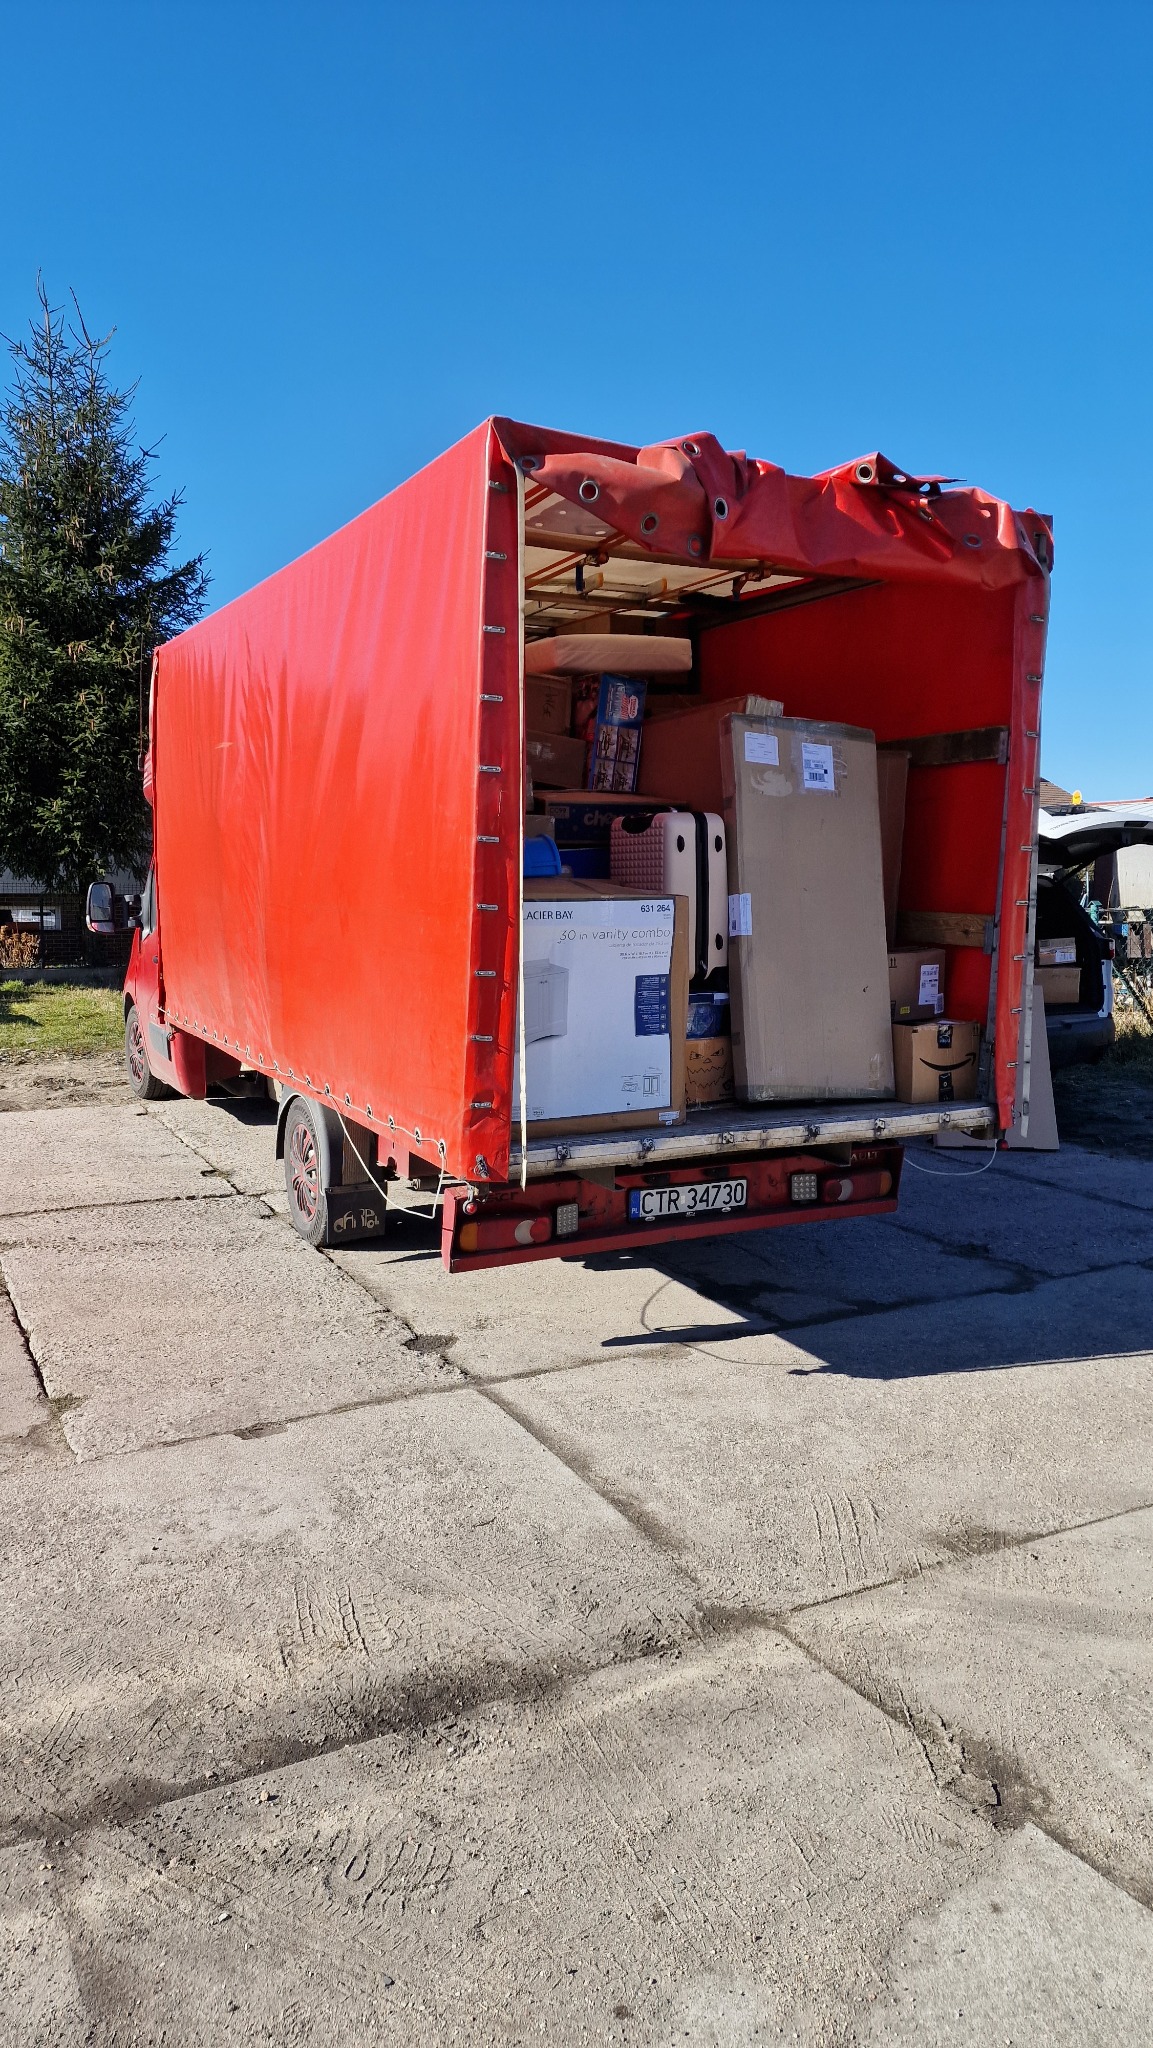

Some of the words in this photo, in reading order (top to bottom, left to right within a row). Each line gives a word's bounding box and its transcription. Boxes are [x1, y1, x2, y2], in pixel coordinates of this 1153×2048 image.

[640, 904, 654, 913] 631
[656, 904, 671, 912] 264
[559, 929, 576, 941] 30
[579, 932, 588, 940] in
[592, 928, 630, 941] vanity
[631, 927, 671, 939] combo
[641, 1189, 680, 1215] CTR
[686, 1182, 744, 1210] 34730
